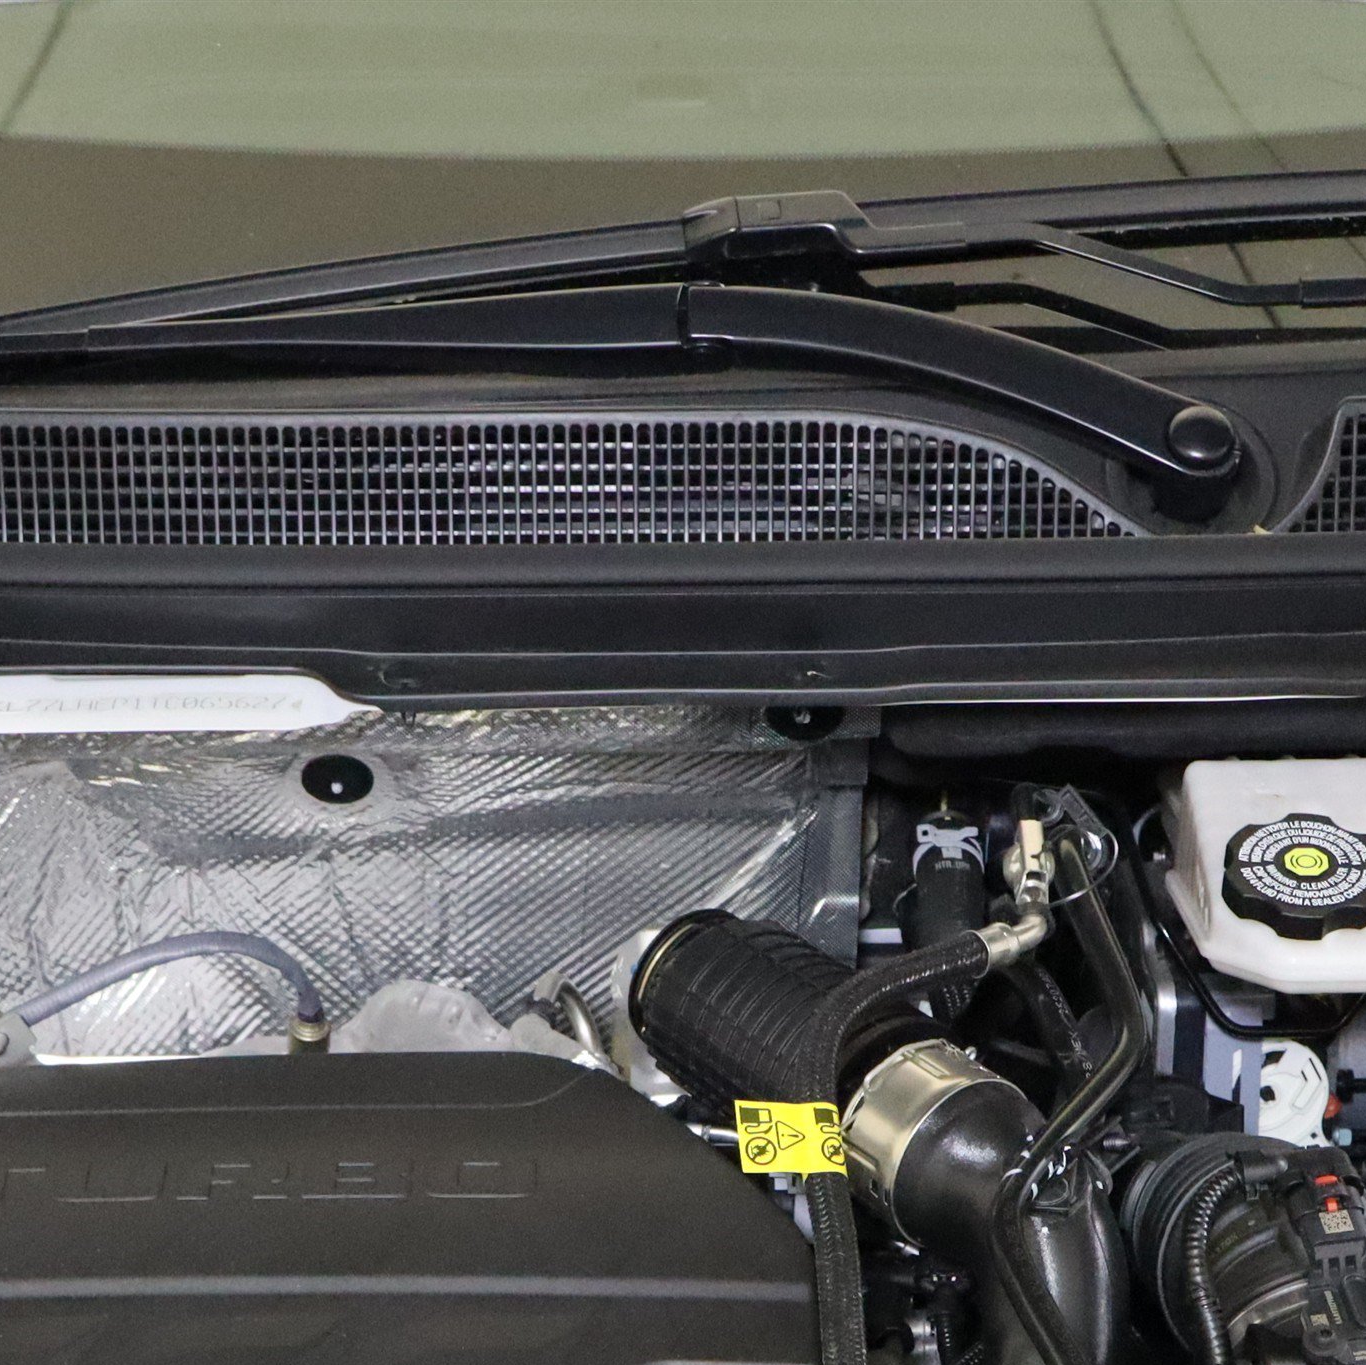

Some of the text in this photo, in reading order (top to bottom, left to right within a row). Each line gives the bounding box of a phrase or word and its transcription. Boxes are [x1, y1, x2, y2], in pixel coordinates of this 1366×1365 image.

[1300, 880, 1331, 890] CLEAN
[1252, 882, 1278, 898] FLUID
[1275, 893, 1303, 905] FROM
[1312, 894, 1347, 906] SEALED
